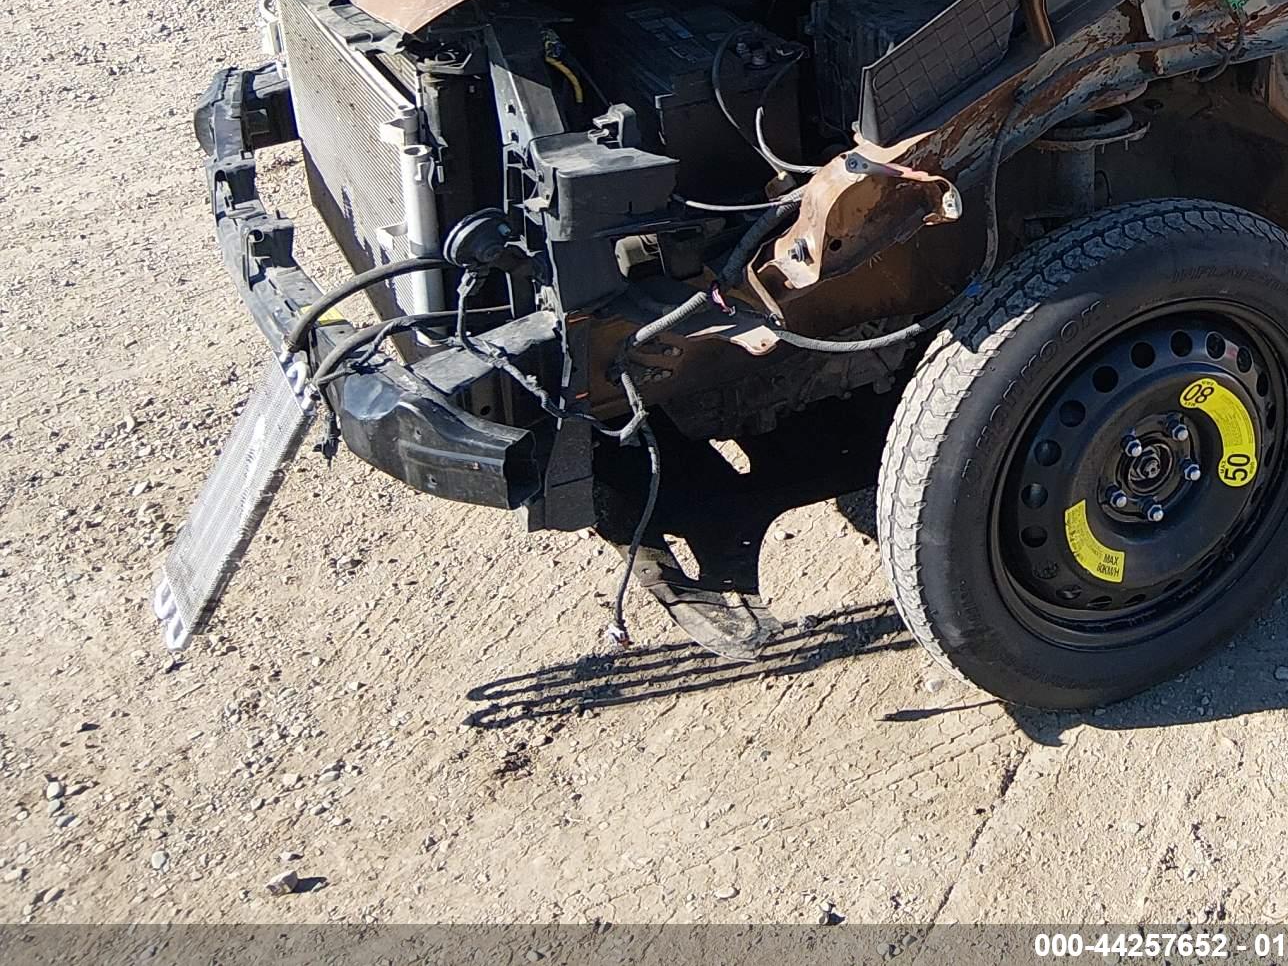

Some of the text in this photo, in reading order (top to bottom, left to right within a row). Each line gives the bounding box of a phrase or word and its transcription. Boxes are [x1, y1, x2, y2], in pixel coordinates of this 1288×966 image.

[1183, 384, 1215, 404] 80
[1224, 454, 1251, 481] 50
[1103, 554, 1119, 566] MAX
